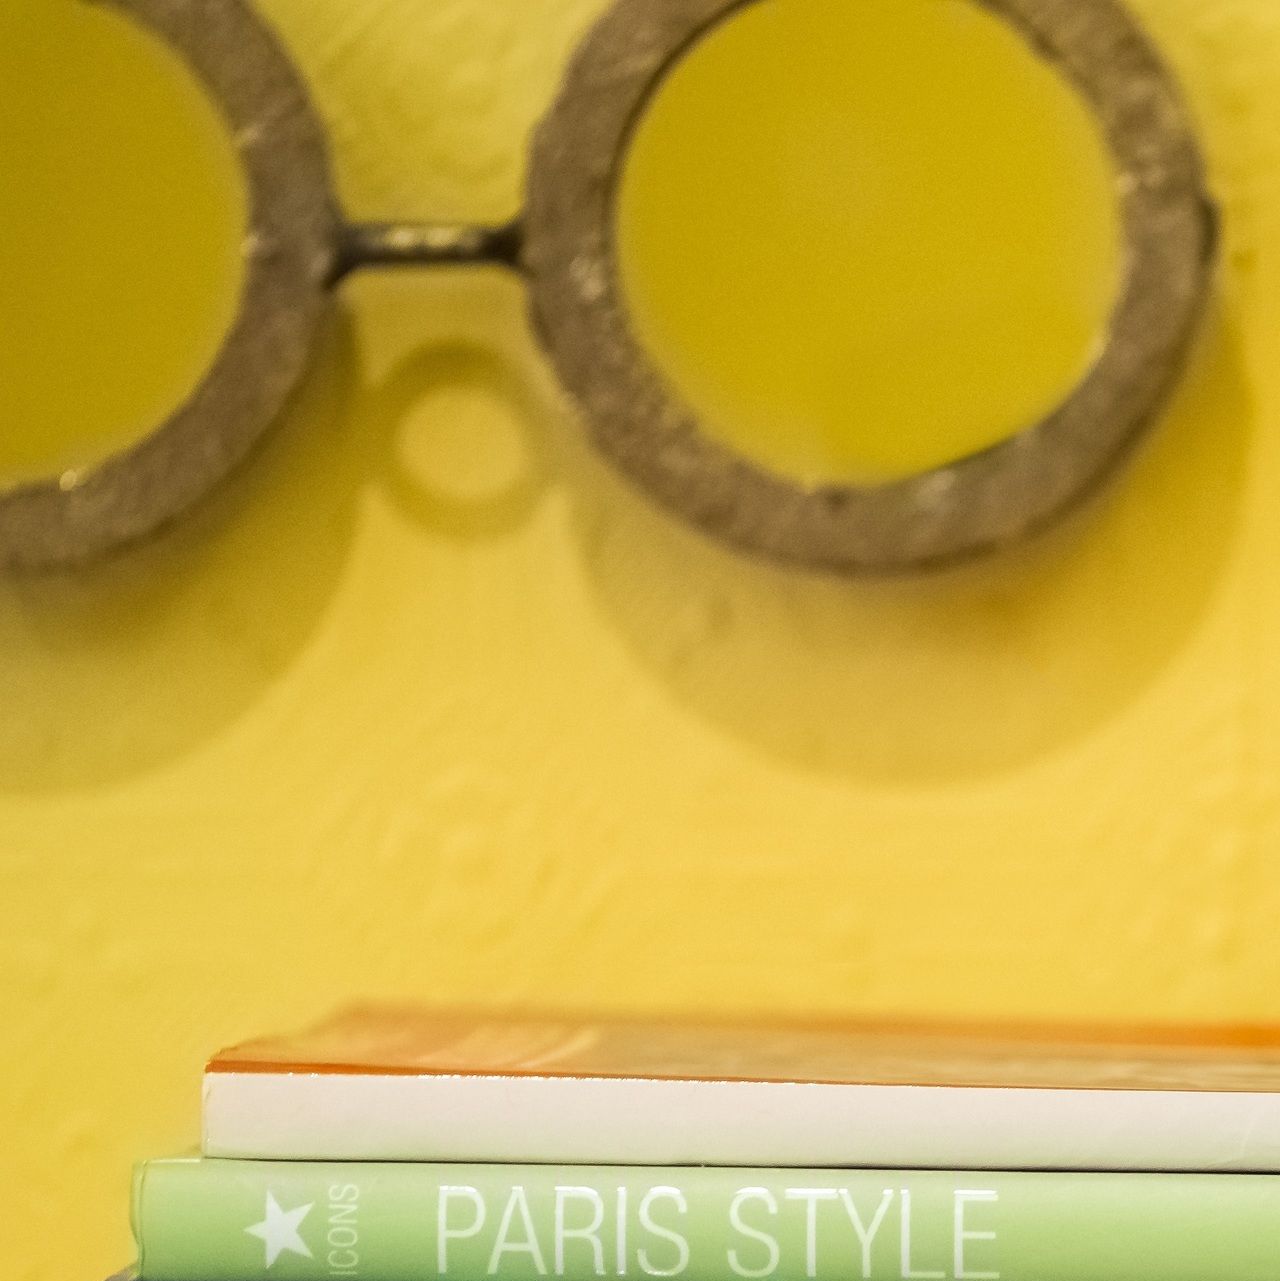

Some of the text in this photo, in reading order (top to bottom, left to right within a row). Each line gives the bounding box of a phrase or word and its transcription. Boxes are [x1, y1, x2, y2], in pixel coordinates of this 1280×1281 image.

[328, 1183, 360, 1275] ICONS
[435, 1184, 1001, 1281] PARIS STYLE
